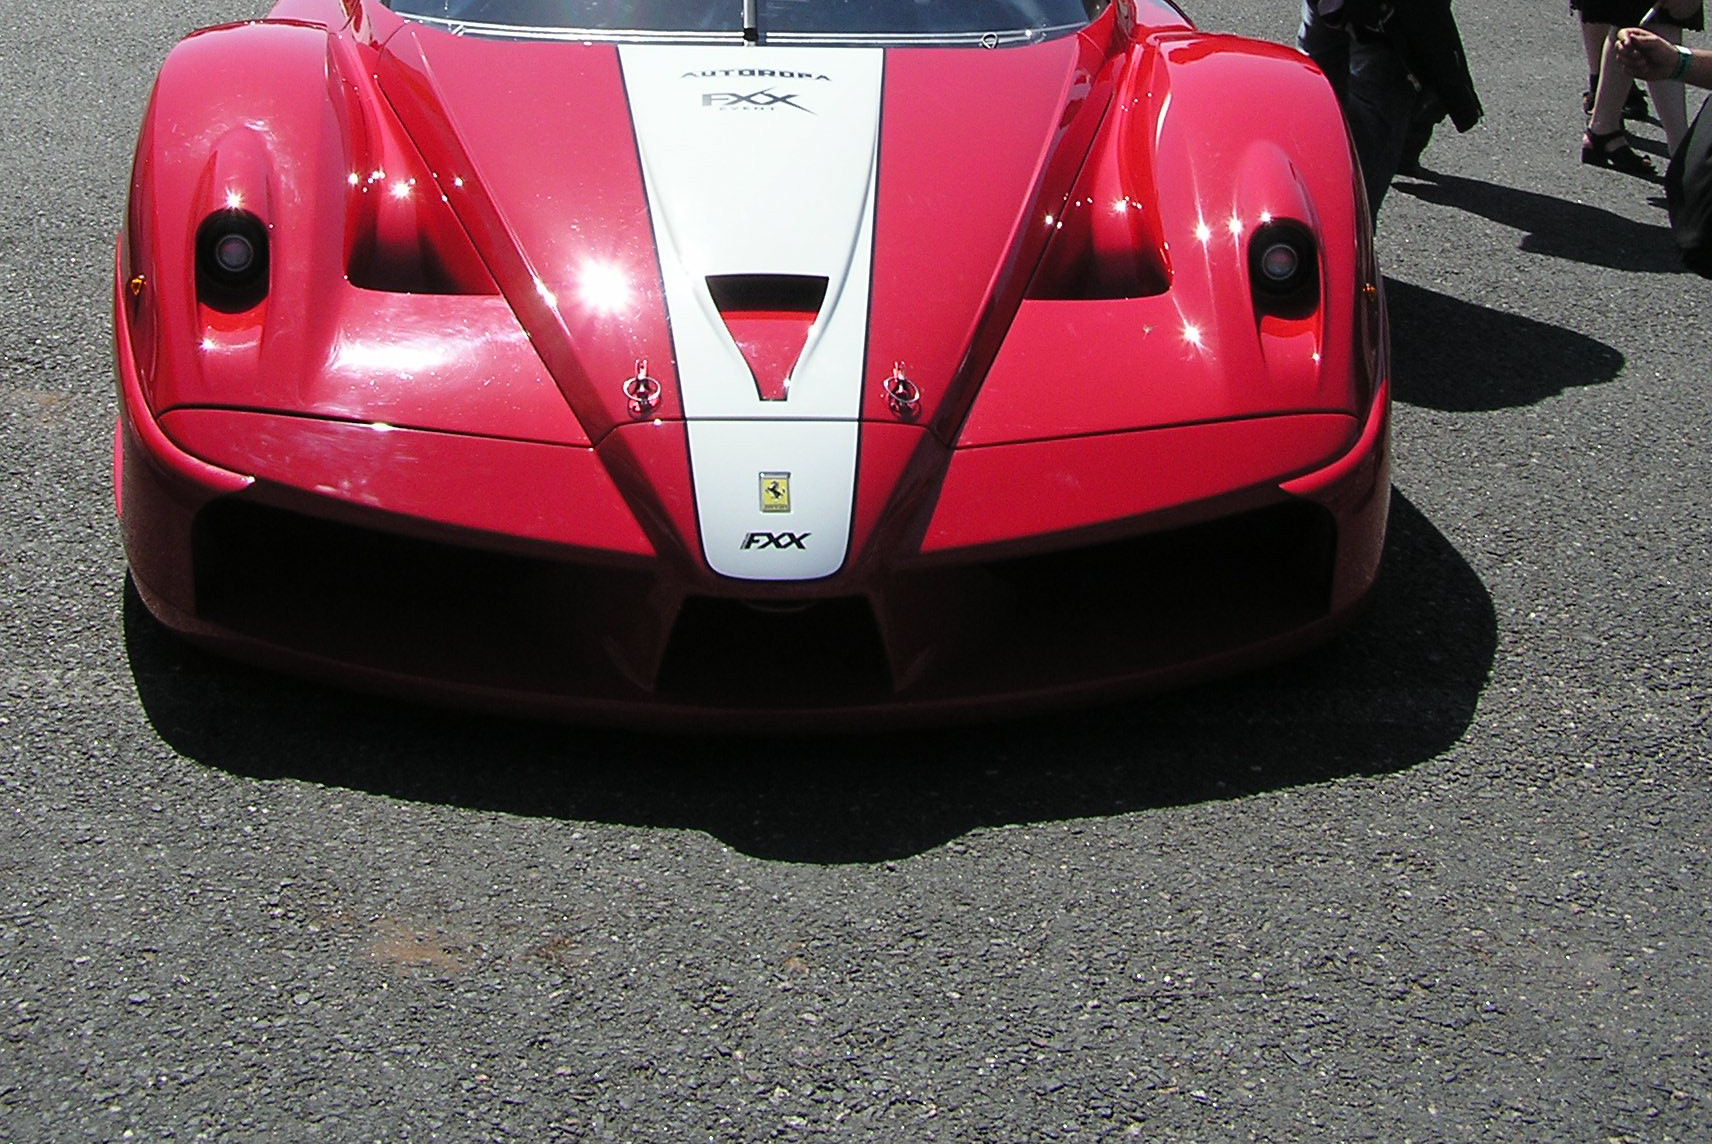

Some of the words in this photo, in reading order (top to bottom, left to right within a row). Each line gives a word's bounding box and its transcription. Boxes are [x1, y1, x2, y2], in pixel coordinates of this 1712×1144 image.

[681, 68, 832, 82] AUTOROPA
[702, 87, 818, 116] FXX
[740, 532, 811, 550] FXX
